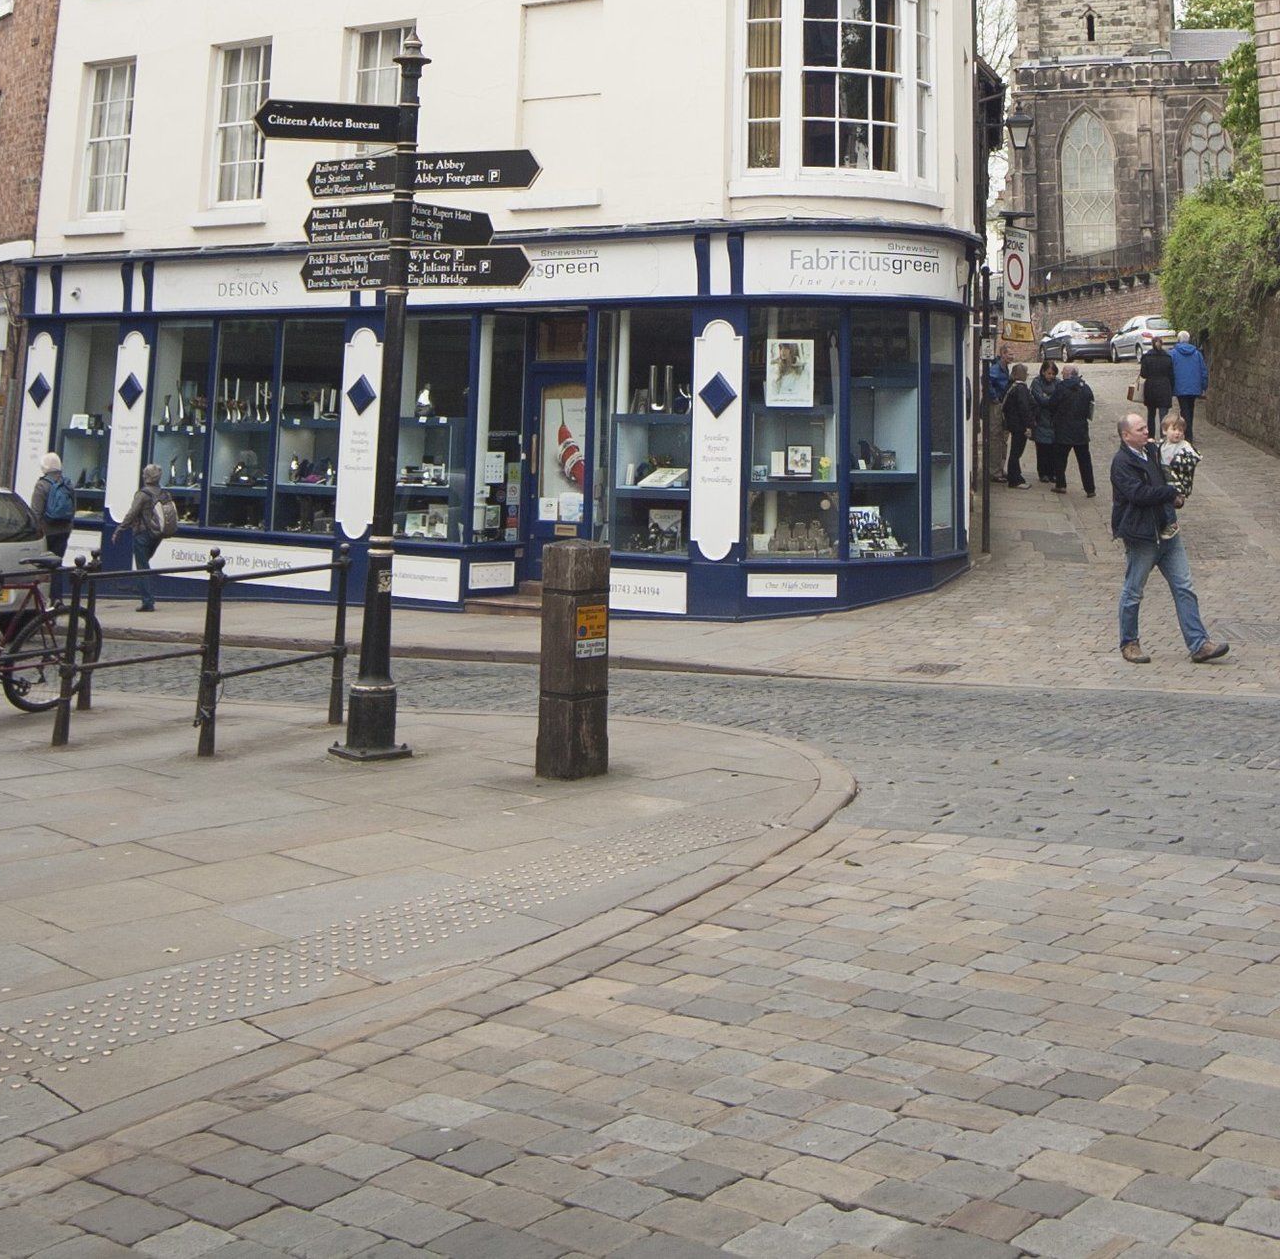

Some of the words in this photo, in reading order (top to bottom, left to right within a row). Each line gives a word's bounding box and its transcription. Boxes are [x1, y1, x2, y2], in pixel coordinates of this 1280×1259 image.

[267, 114, 308, 126] Citizens
[308, 117, 343, 128] Advice
[345, 118, 380, 130] Bureau
[315, 163, 339, 173] Railway
[340, 161, 364, 170] Station
[416, 161, 434, 171] The
[435, 159, 466, 172] Abbey
[315, 175, 326, 184] Bus
[328, 174, 351, 183] Station
[414, 173, 444, 186] Abbey
[446, 172, 485, 186] Foregate
[369, 182, 396, 191] Museum
[312, 209, 331, 219] Music
[332, 208, 347, 218] Hall
[411, 204, 431, 215] Prince
[432, 206, 454, 220] Rupert
[455, 210, 472, 221] Hotel
[312, 222, 338, 231] Museum
[338, 220, 345, 229] &
[345, 220, 357, 229] Art
[358, 218, 384, 228] Gallery
[411, 217, 425, 227] Bear
[427, 218, 443, 231] Steps
[311, 233, 333, 242] Tourist
[334, 231, 373, 241] Information
[411, 230, 432, 241] Toilets
[540, 248, 599, 257] Shrewsbury
[888, 242, 940, 255] Shrewsbury
[1007, 240, 1024, 253] ZONE
[309, 255, 324, 265] Pride
[325, 253, 338, 264] Hill
[339, 253, 368, 265] Shopping
[369, 252, 391, 261] Centre
[410, 251, 432, 263] Wyle
[433, 249, 451, 263] Cop
[789, 248, 940, 275] Fabriciusgreen
[312, 267, 323, 276] and
[324, 265, 353, 276] Riverside
[353, 263, 369, 273] Mall
[408, 263, 420, 272] St.
[421, 262, 450, 274] Julians
[451, 261, 477, 272] Friars
[308, 279, 330, 289] Darwin
[331, 278, 360, 290] Shopping
[361, 276, 382, 286] Centre
[407, 275, 438, 287] English
[440, 275, 468, 286] Bridge
[217, 281, 280, 297] DESIGNS
[170, 549, 206, 563] Fabricius
[236, 555, 251, 567] the
[252, 556, 292, 570] jewellers
[632, 585, 660, 596] 244194
